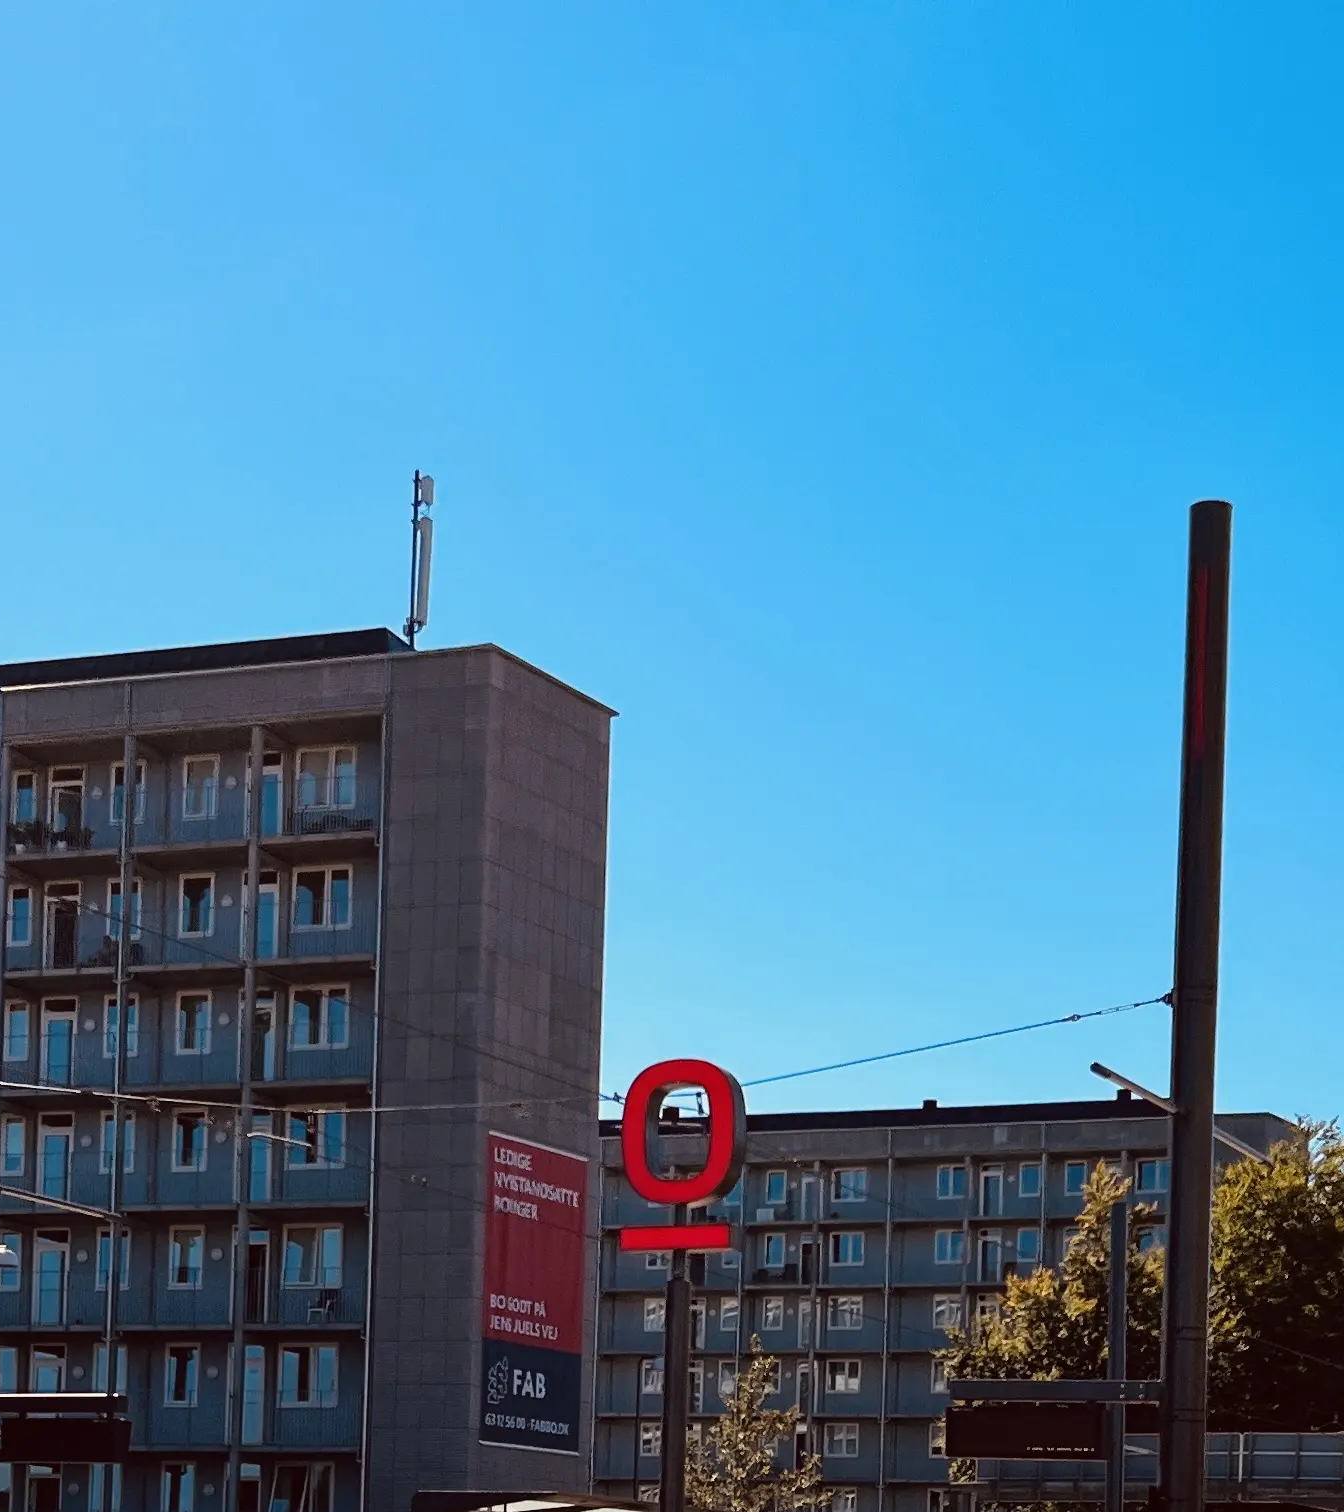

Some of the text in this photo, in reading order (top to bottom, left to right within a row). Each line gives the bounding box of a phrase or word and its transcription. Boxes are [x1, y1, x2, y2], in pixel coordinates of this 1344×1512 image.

[494, 1147, 533, 1171] LEDIGE
[489, 1293, 547, 1318] BO GODT PÅ
[489, 1314, 559, 1341] JENS JUELS VEJ
[512, 1368, 547, 1399] FAB
[484, 1412, 496, 1426] 63
